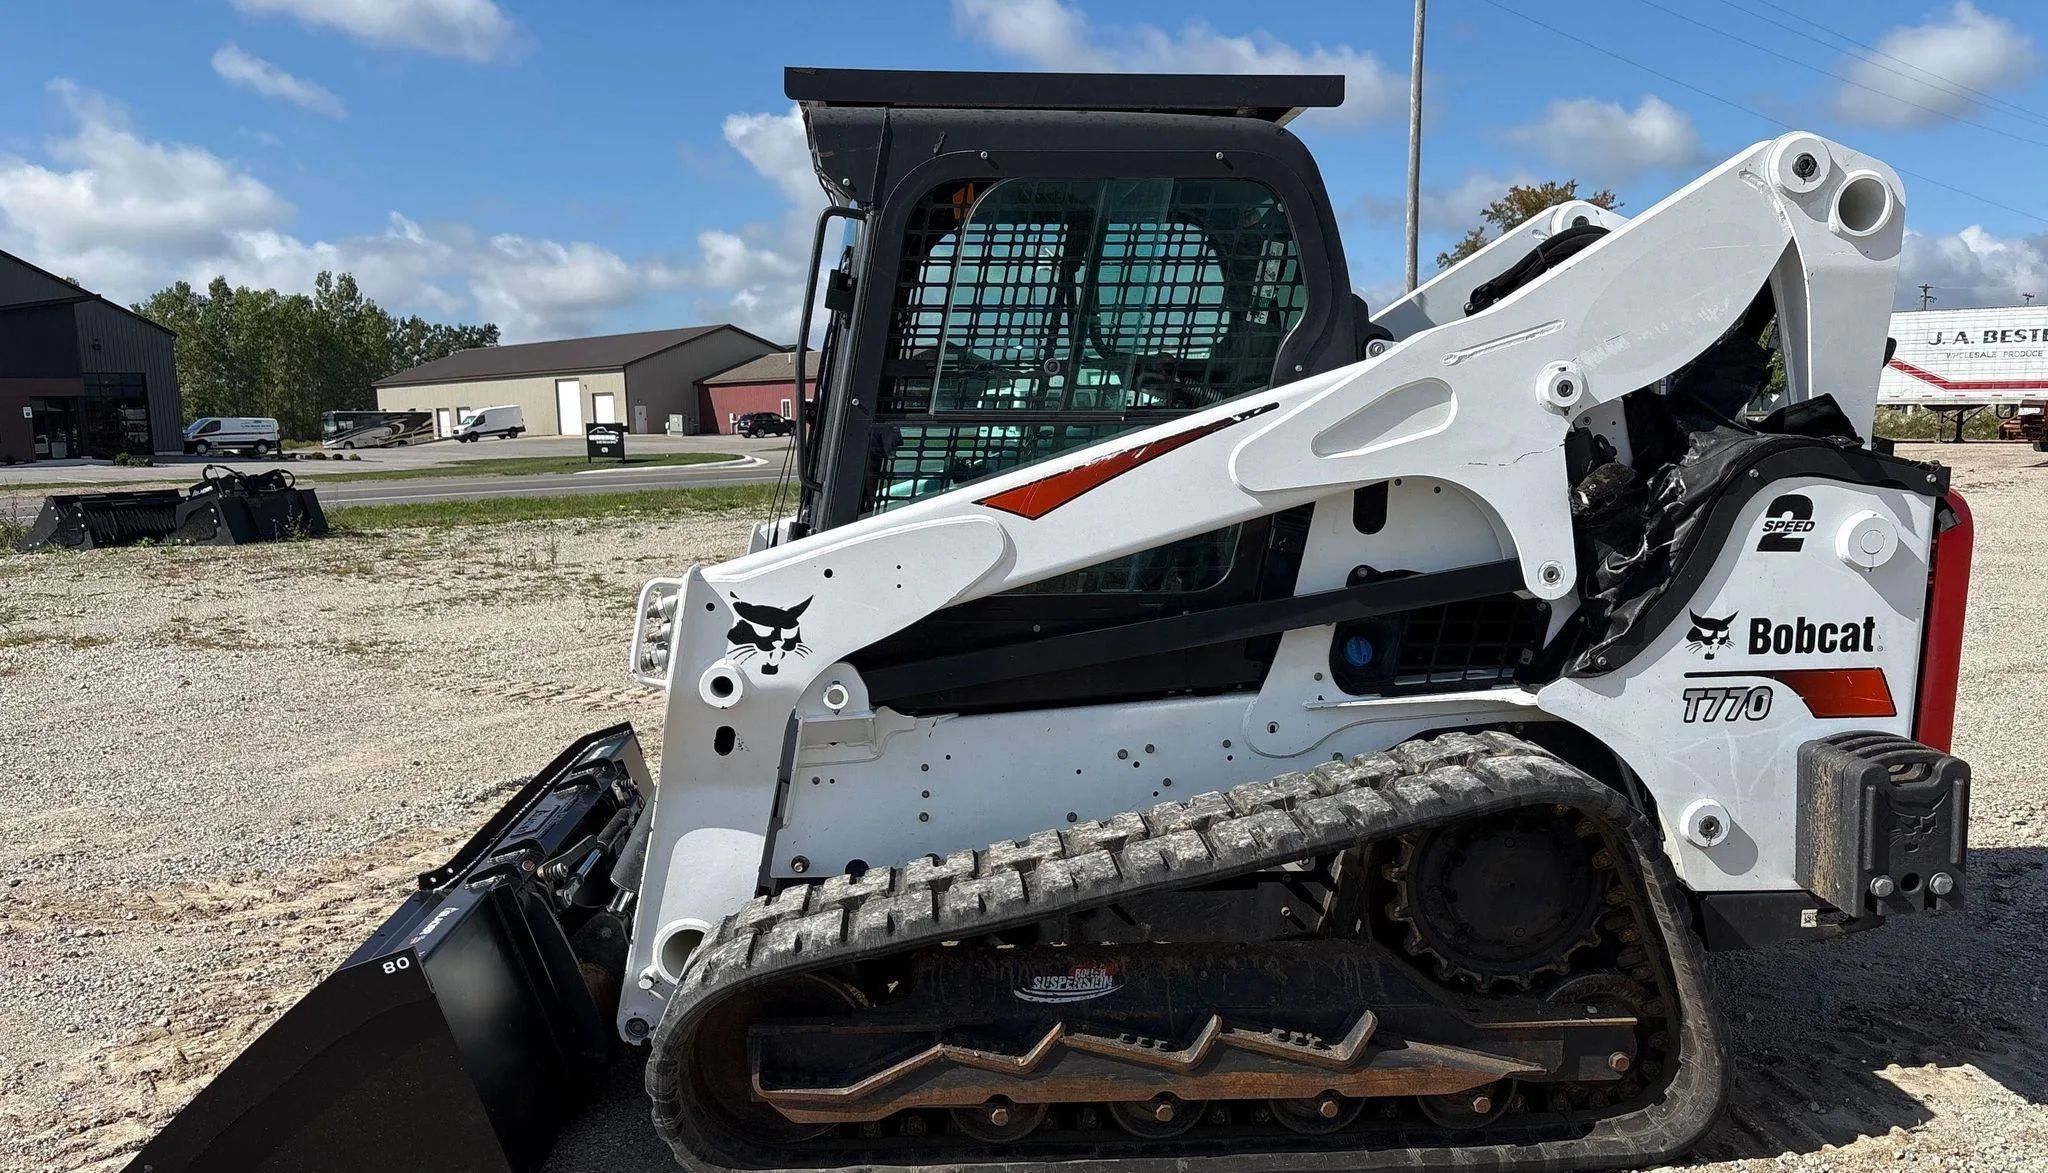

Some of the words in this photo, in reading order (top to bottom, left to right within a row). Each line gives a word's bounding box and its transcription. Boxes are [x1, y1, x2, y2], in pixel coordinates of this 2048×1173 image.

[1928, 331, 1946, 345] J.
[1952, 331, 1975, 344] A.
[2003, 350, 2043, 358] PRODUCE
[1756, 494, 1814, 552] 2
[1762, 520, 1816, 532] SPEED
[1748, 616, 1876, 655] Bobcat
[1683, 686, 1774, 723] T770
[382, 956, 410, 975] 80
[1032, 976, 1113, 990] SUSPENSION
